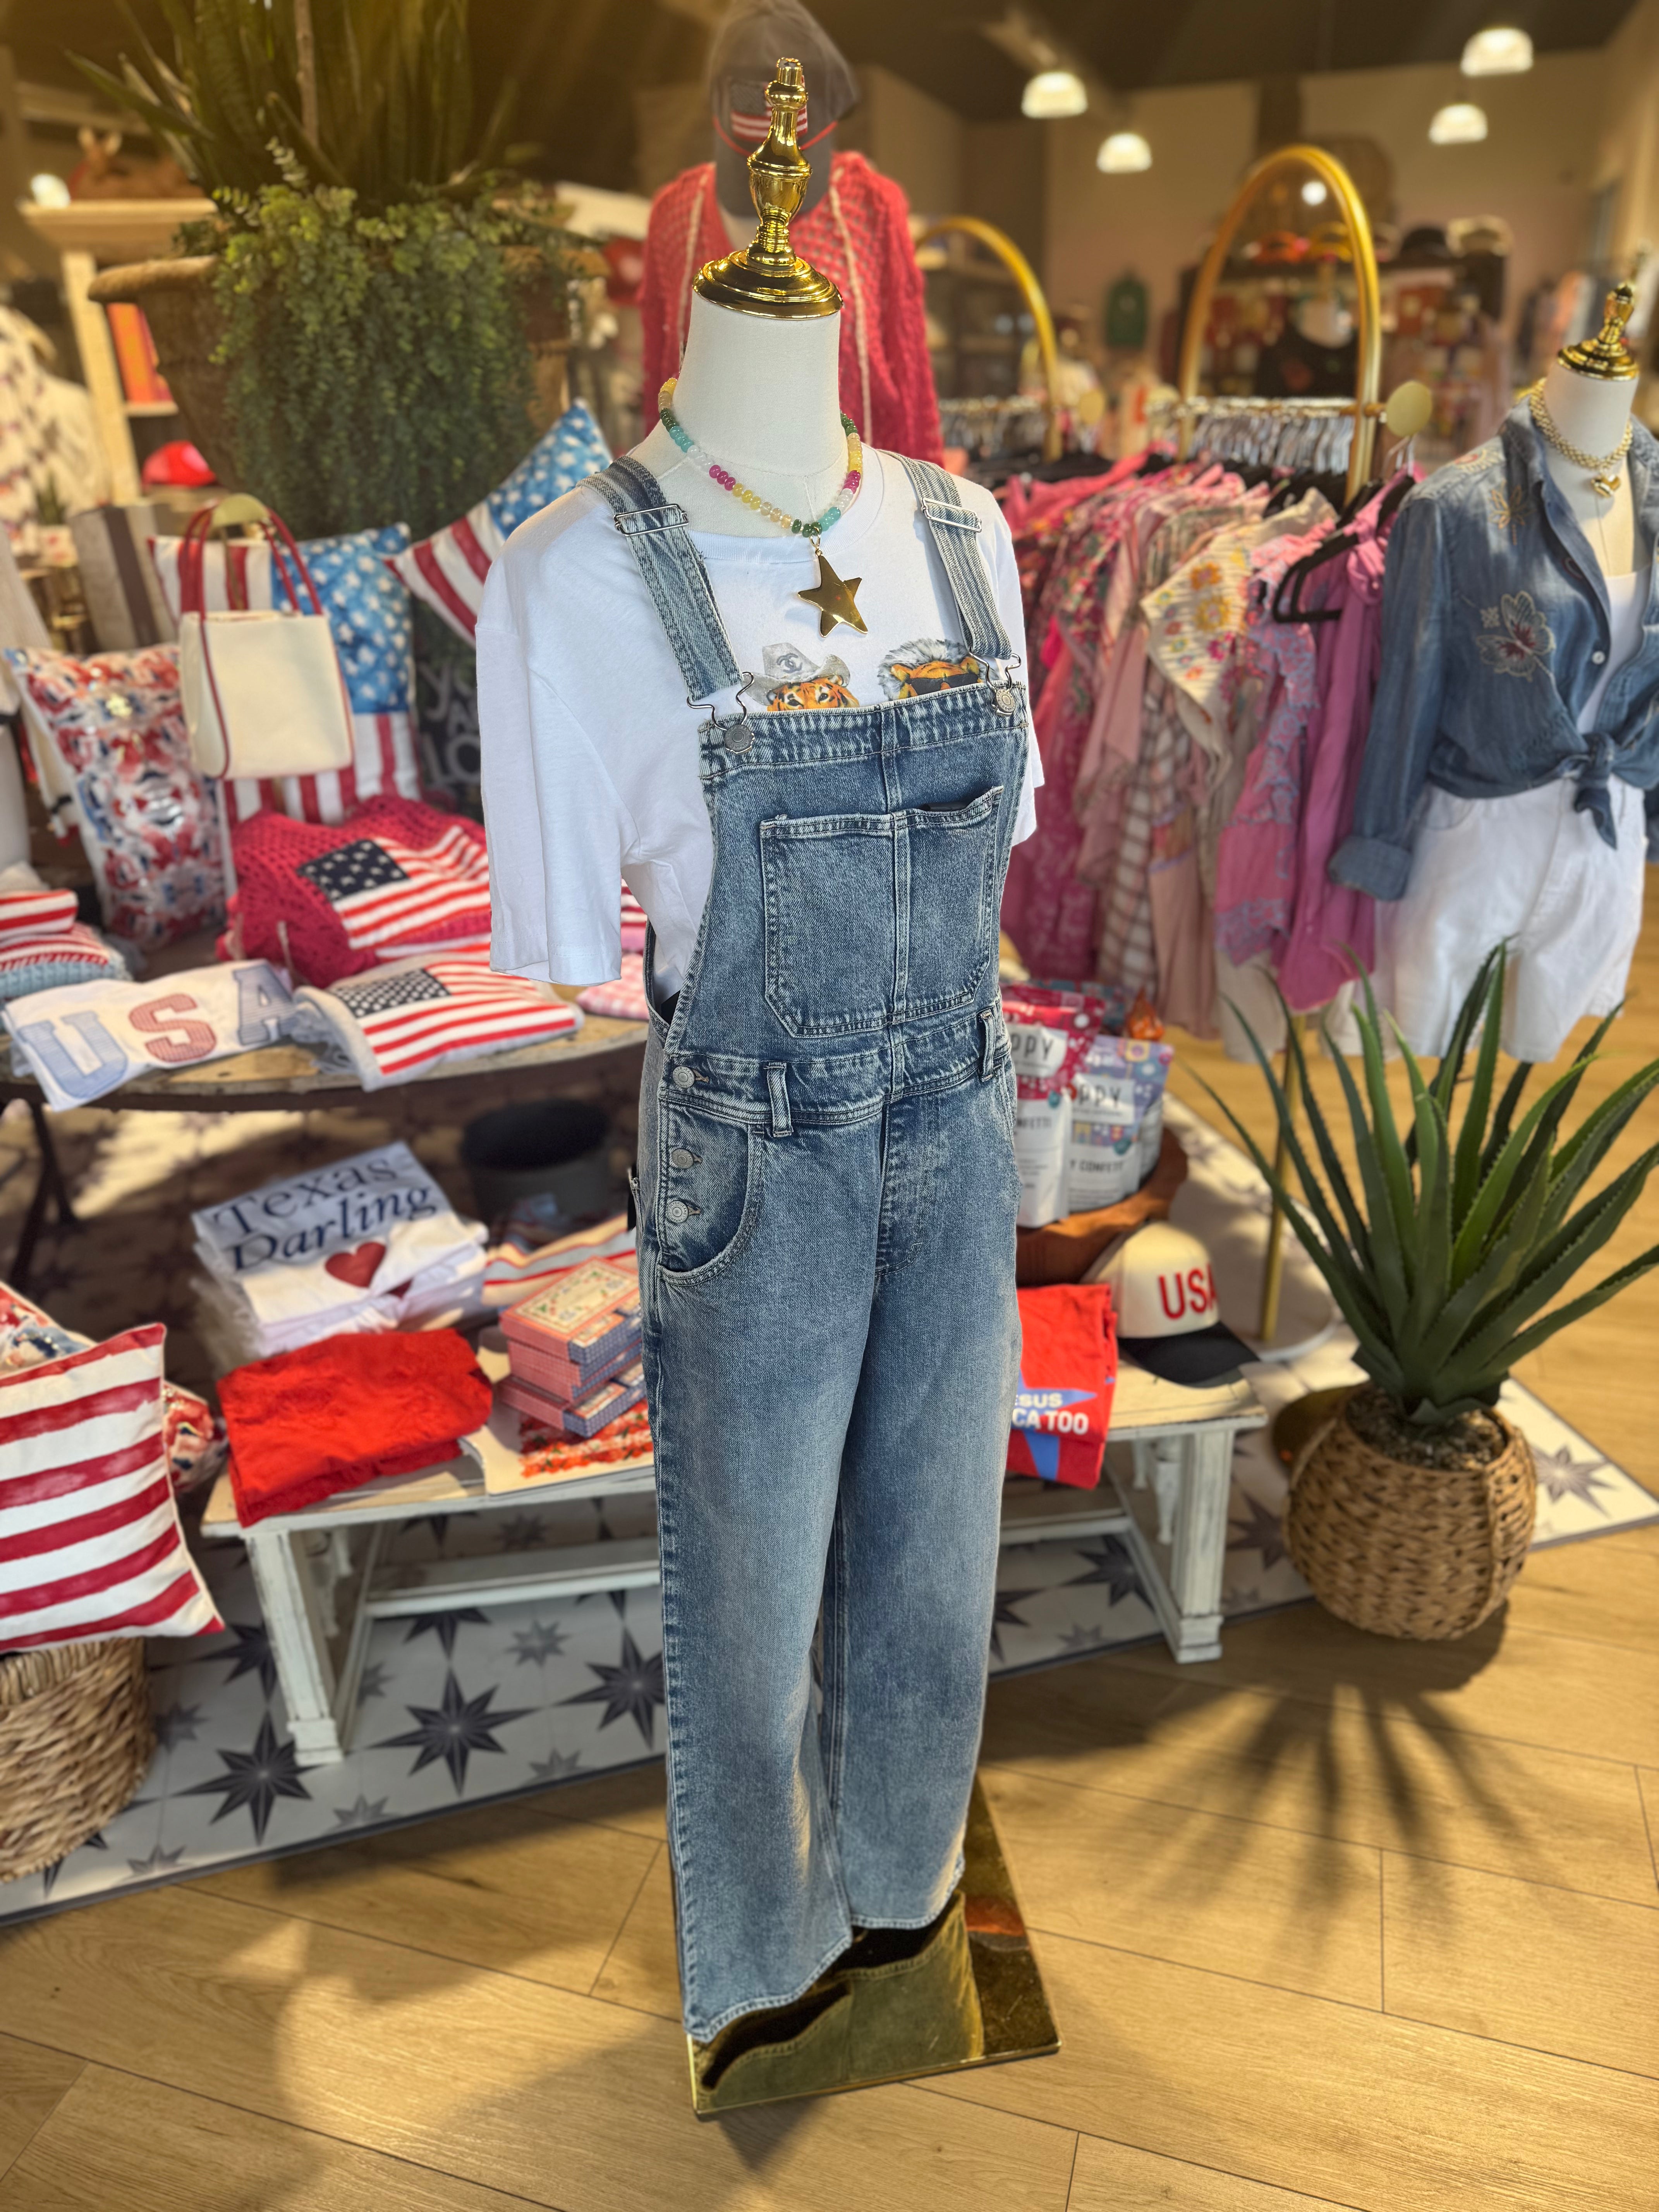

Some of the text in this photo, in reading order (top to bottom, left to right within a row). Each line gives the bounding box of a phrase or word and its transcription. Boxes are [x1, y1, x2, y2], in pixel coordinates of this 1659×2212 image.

[17, 963, 298, 1100] USA
[214, 1159, 398, 1235] Texas
[222, 1187, 437, 1271] Darling
[1014, 1392, 1063, 1408] SUS
[1044, 1410, 1089, 1435] TOO
